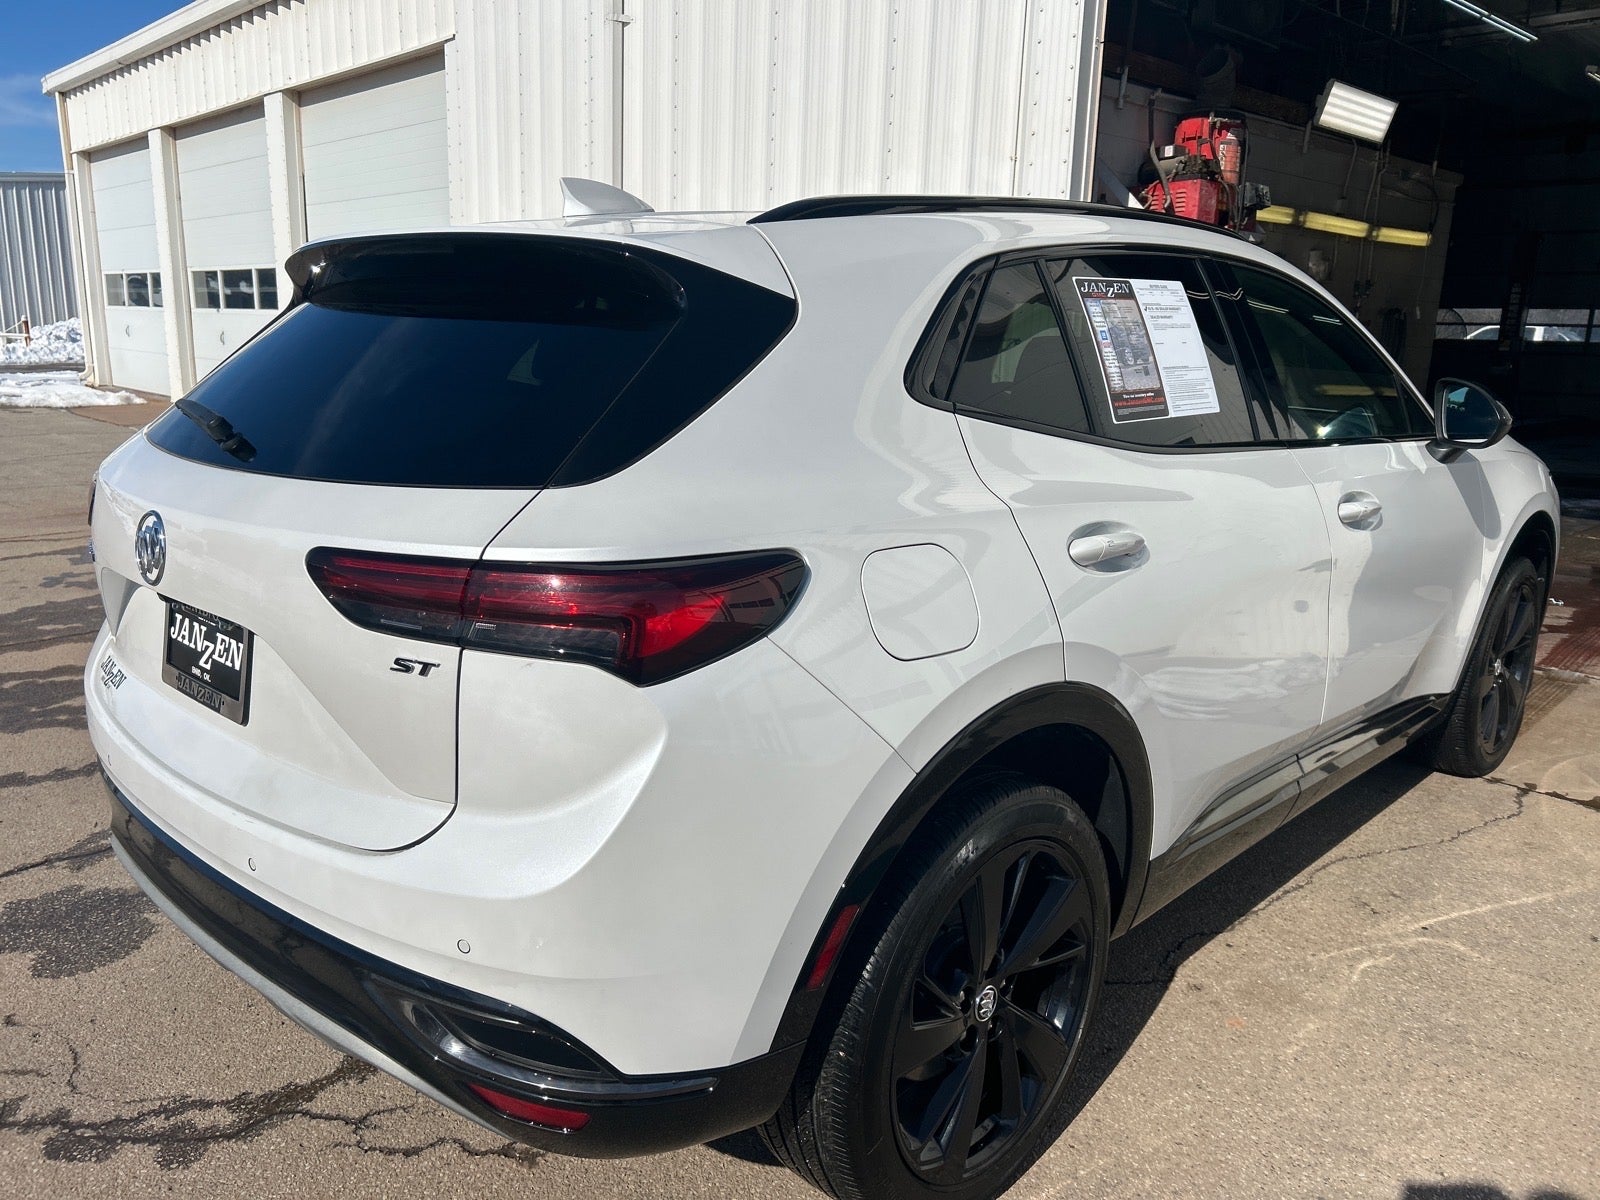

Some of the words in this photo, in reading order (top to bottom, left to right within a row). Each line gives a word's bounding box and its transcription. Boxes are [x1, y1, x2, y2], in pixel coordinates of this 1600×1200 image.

[1081, 281, 1129, 298] JANZEN
[170, 613, 244, 671] JANZEN
[101, 655, 127, 690] JANZEN
[390, 657, 441, 678] ST
[178, 675, 222, 709] JANZEN
